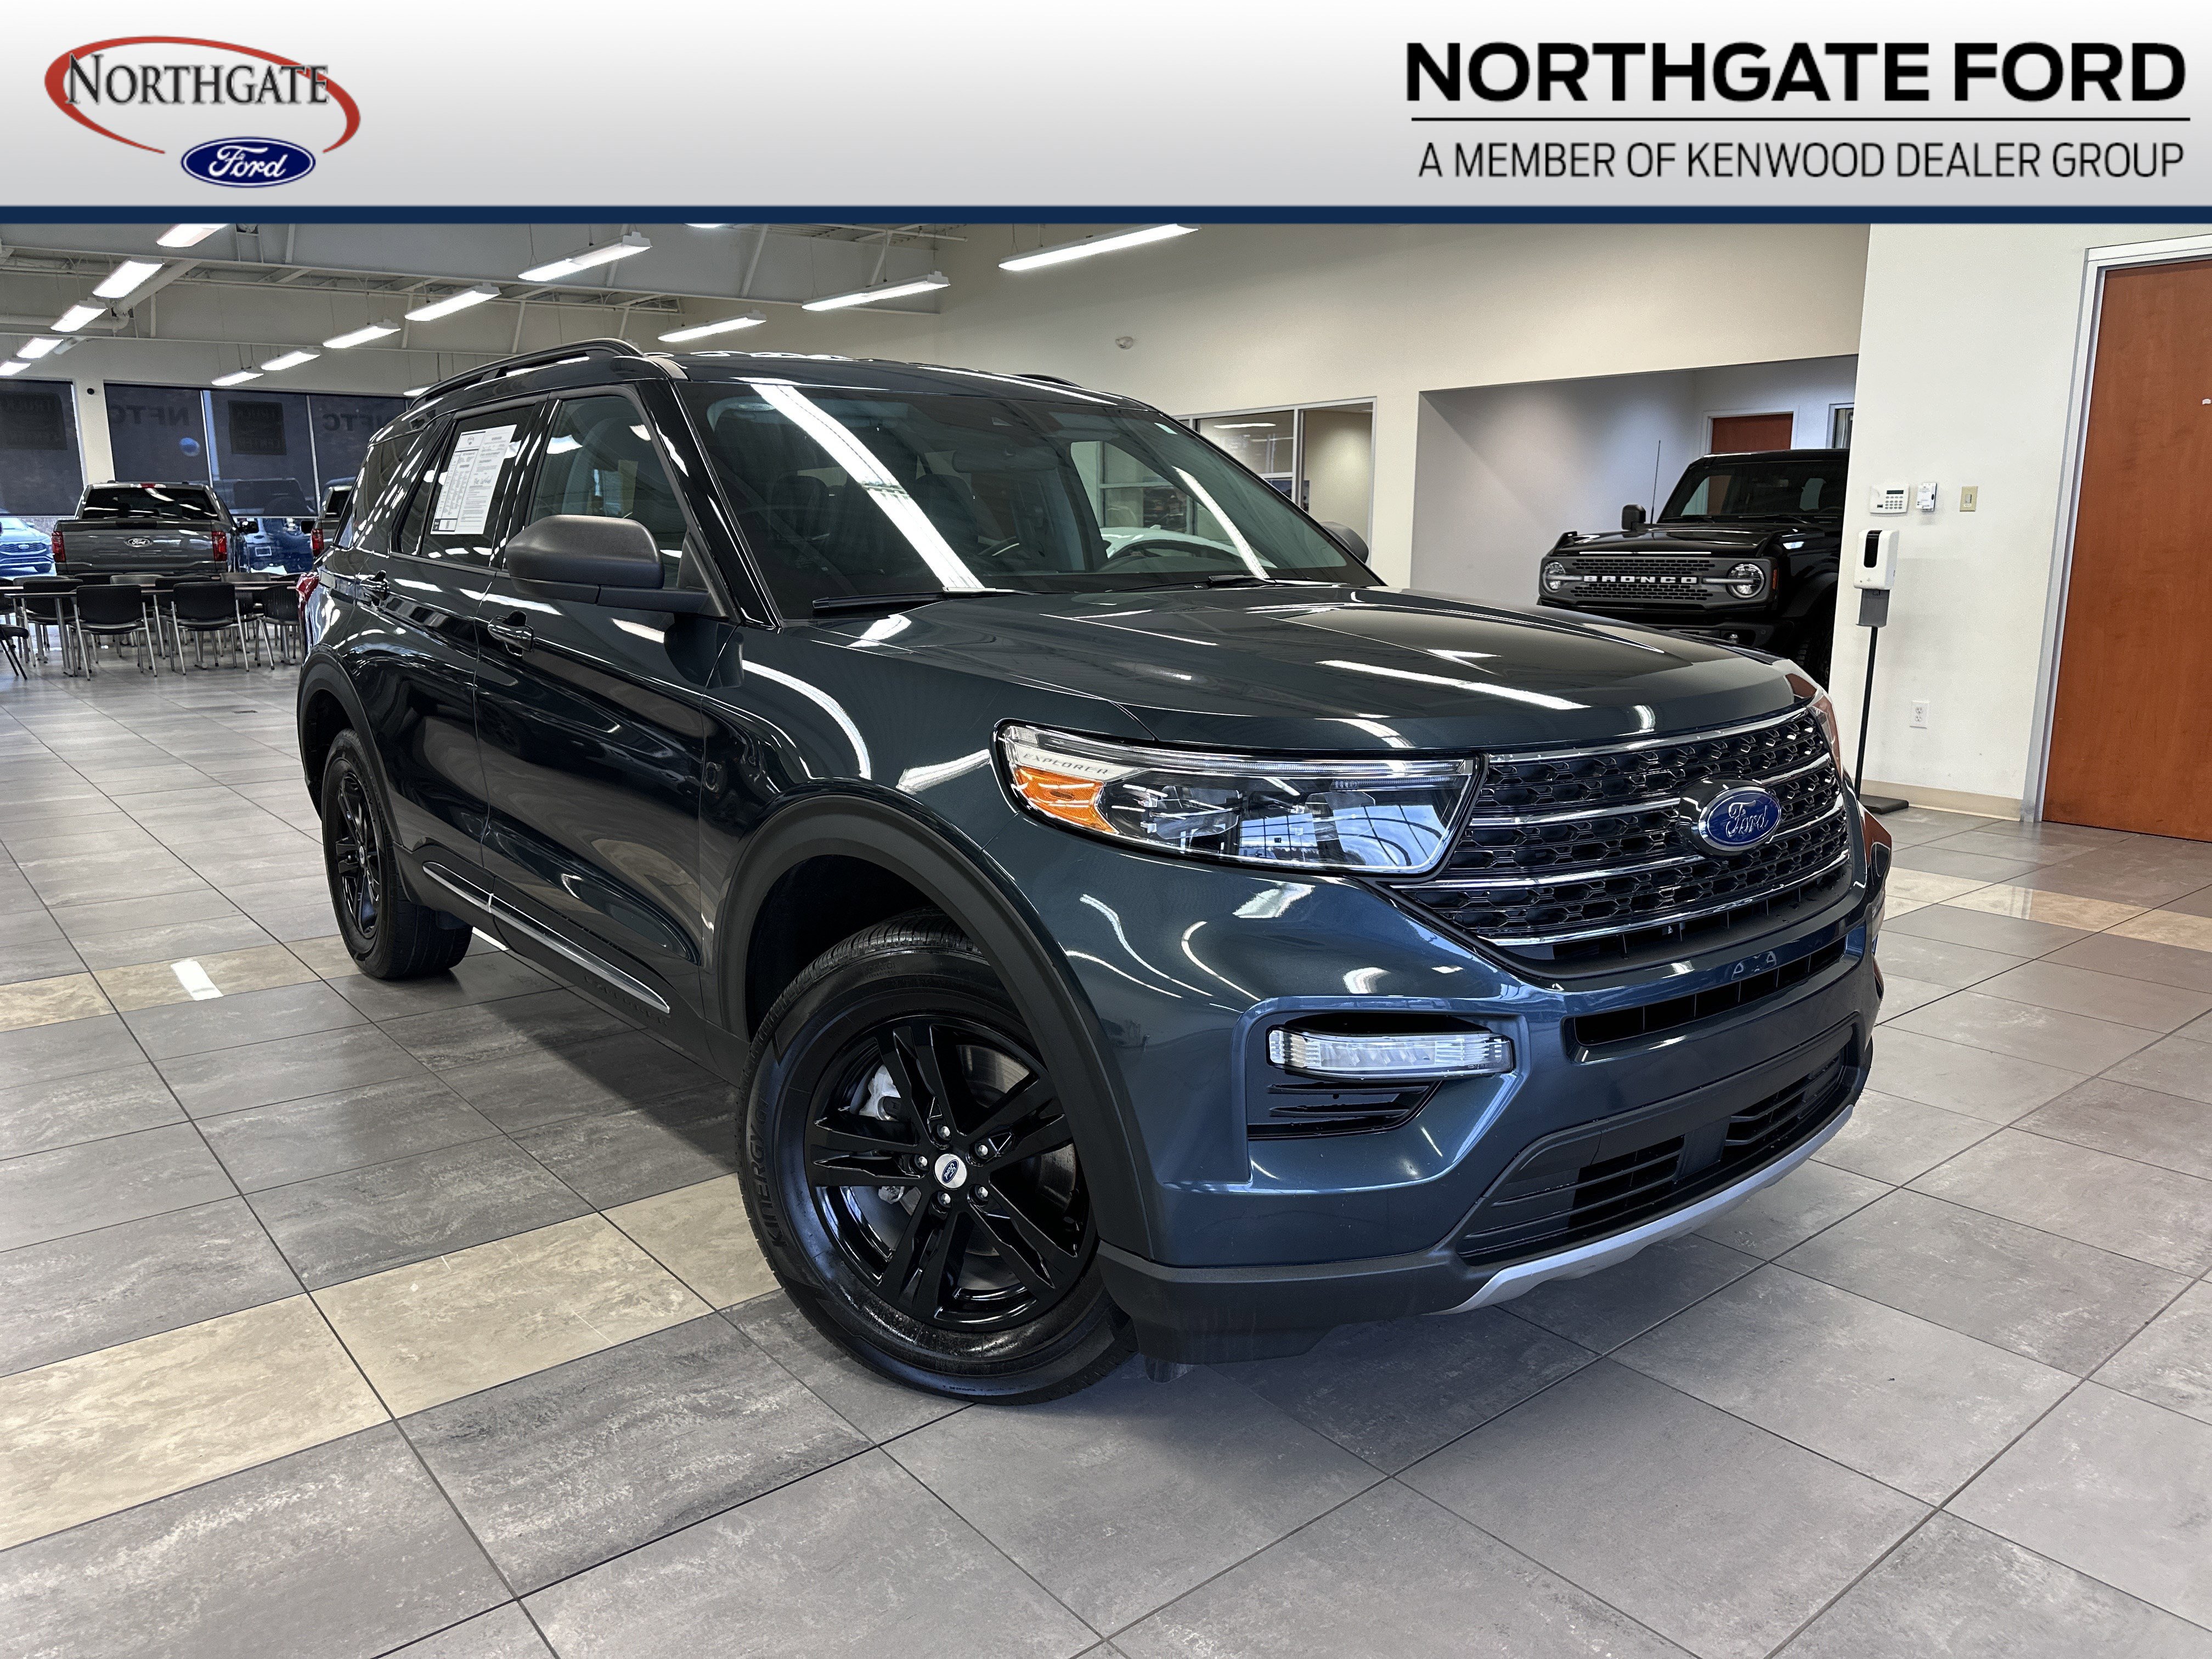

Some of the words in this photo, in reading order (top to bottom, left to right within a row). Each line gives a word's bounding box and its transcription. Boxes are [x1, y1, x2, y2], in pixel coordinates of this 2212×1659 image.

[1583, 575, 1697, 584] BRONCO
[1023, 753, 1109, 775] EXPLORER
[1725, 799, 1769, 838] Ford
[944, 1163, 956, 1180] Ford
